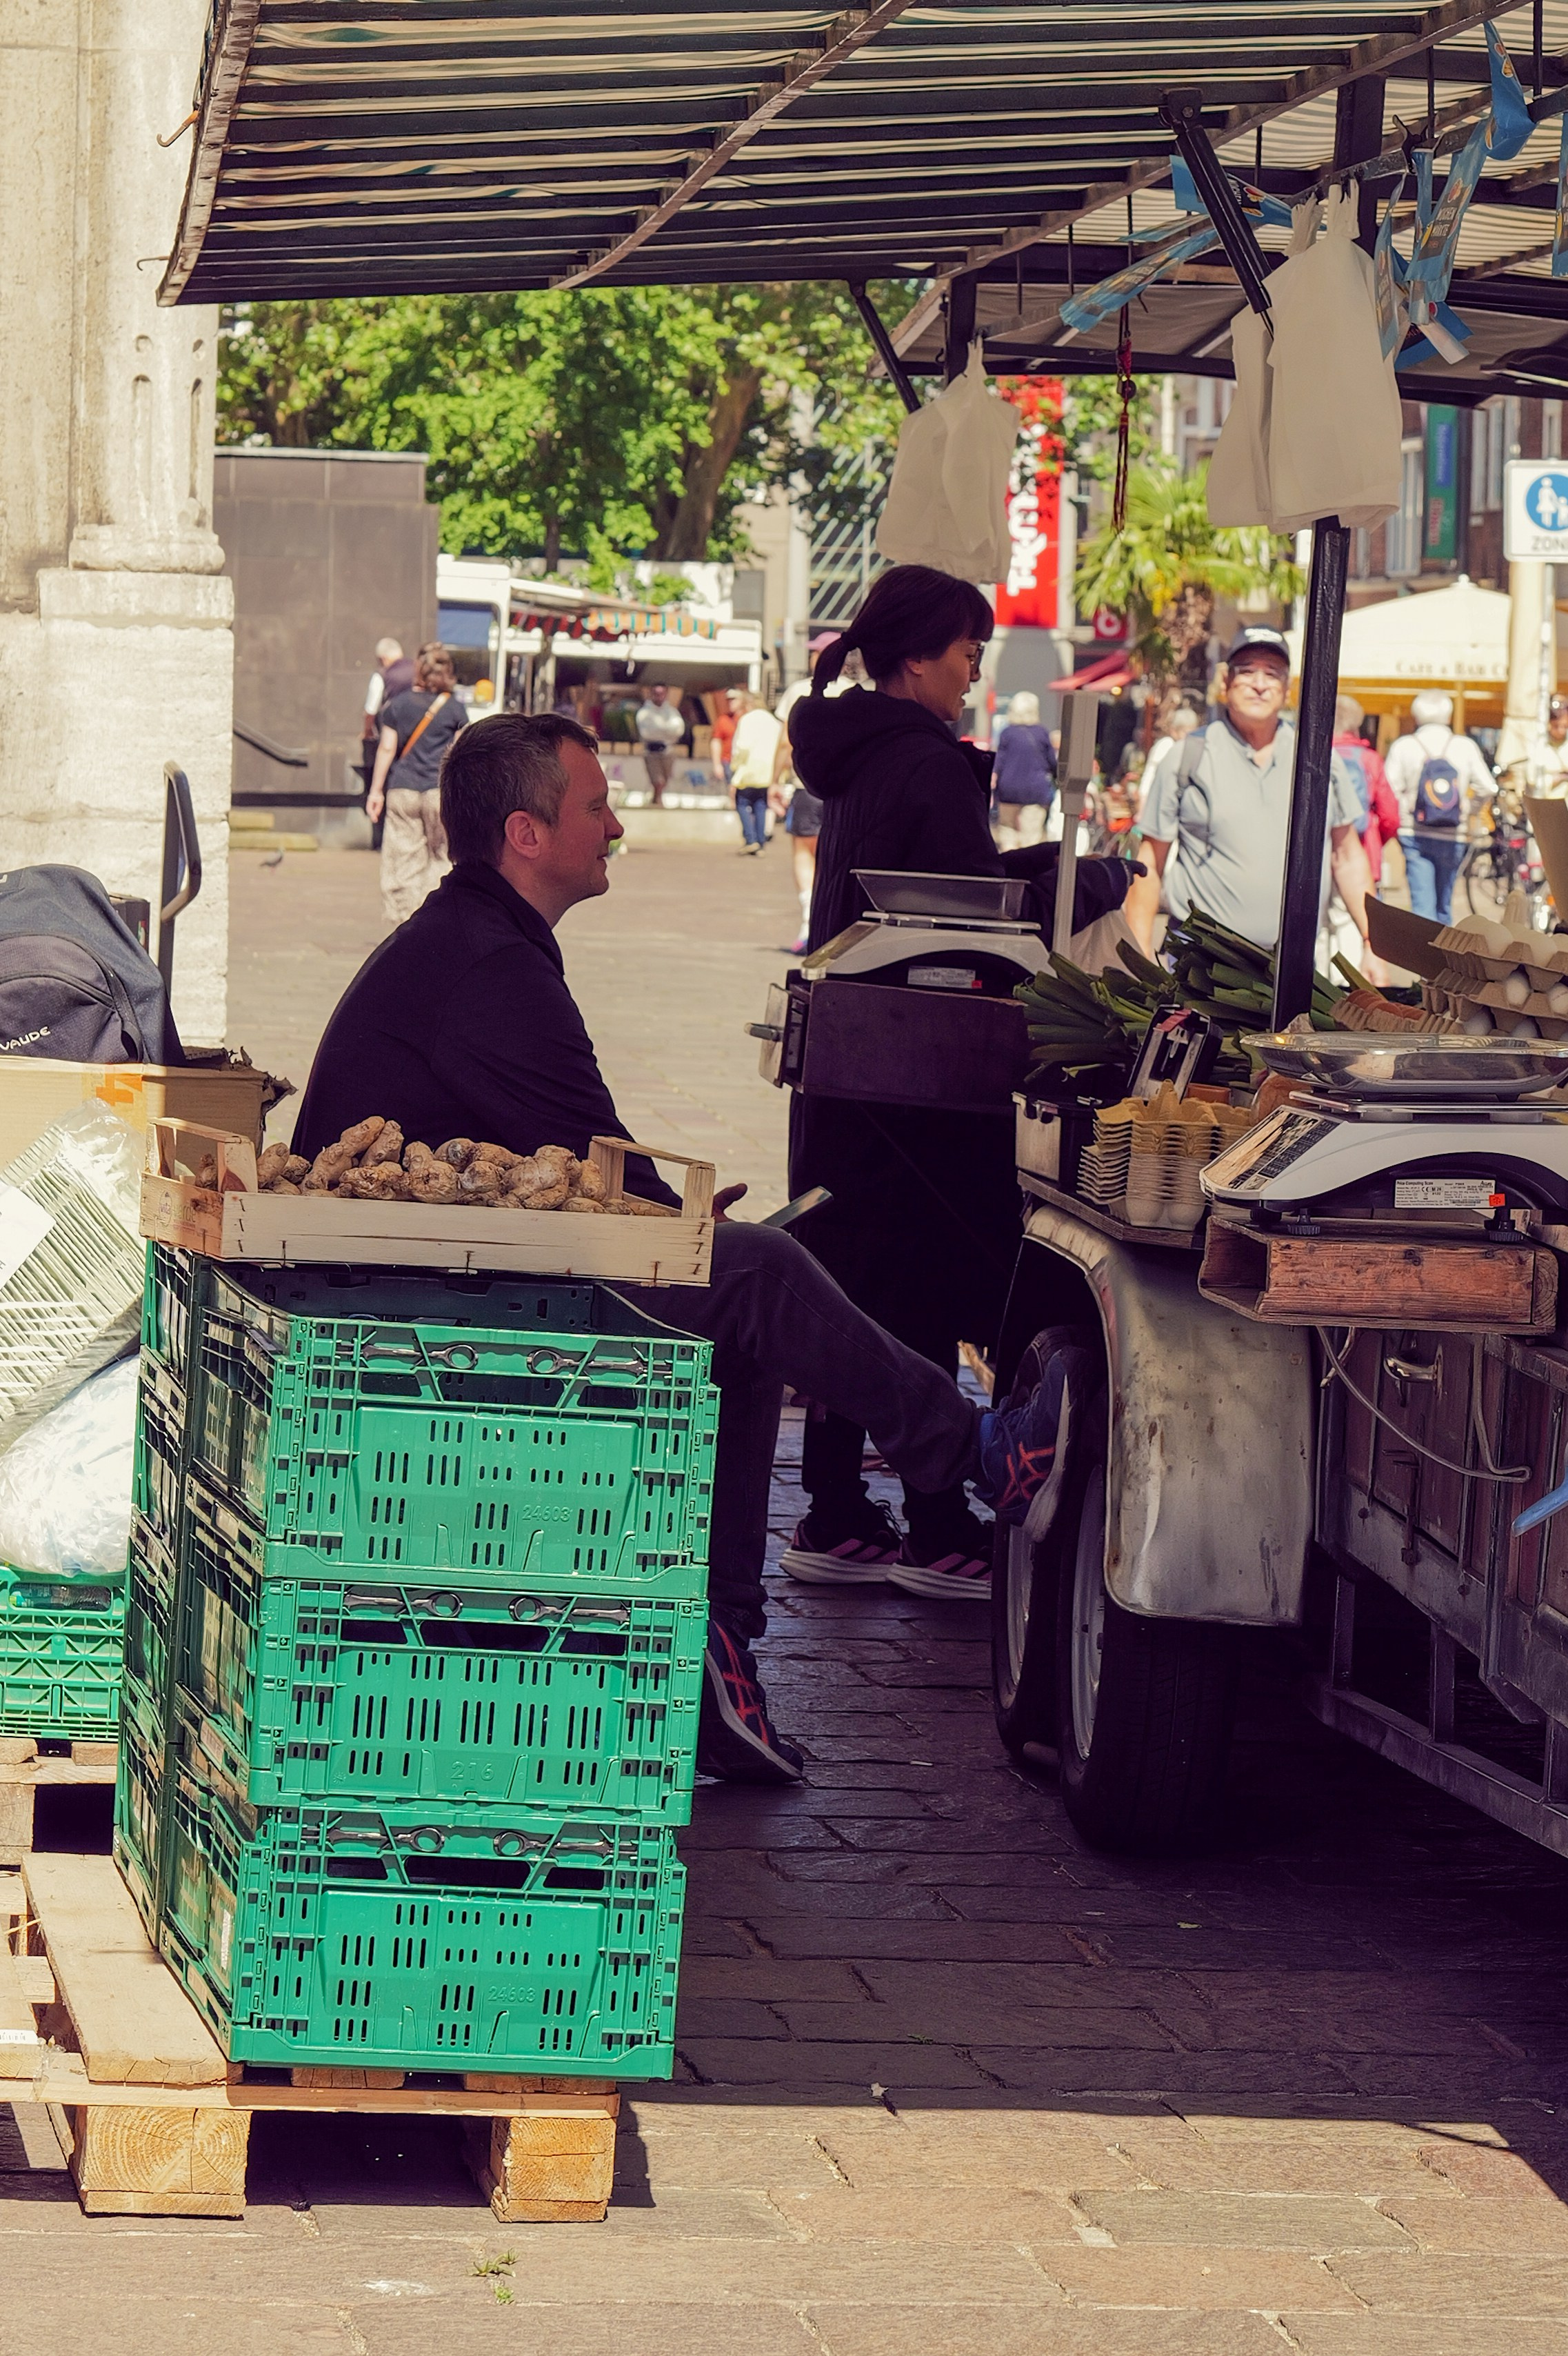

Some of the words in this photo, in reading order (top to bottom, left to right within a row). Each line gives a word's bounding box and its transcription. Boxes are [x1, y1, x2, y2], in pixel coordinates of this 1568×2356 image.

[1531, 535, 1568, 552] ZON
[0, 1026, 51, 1051] VAUDE
[522, 1504, 571, 1522] 24603
[450, 1761, 495, 1781] 216
[488, 1985, 536, 2004] 24603
